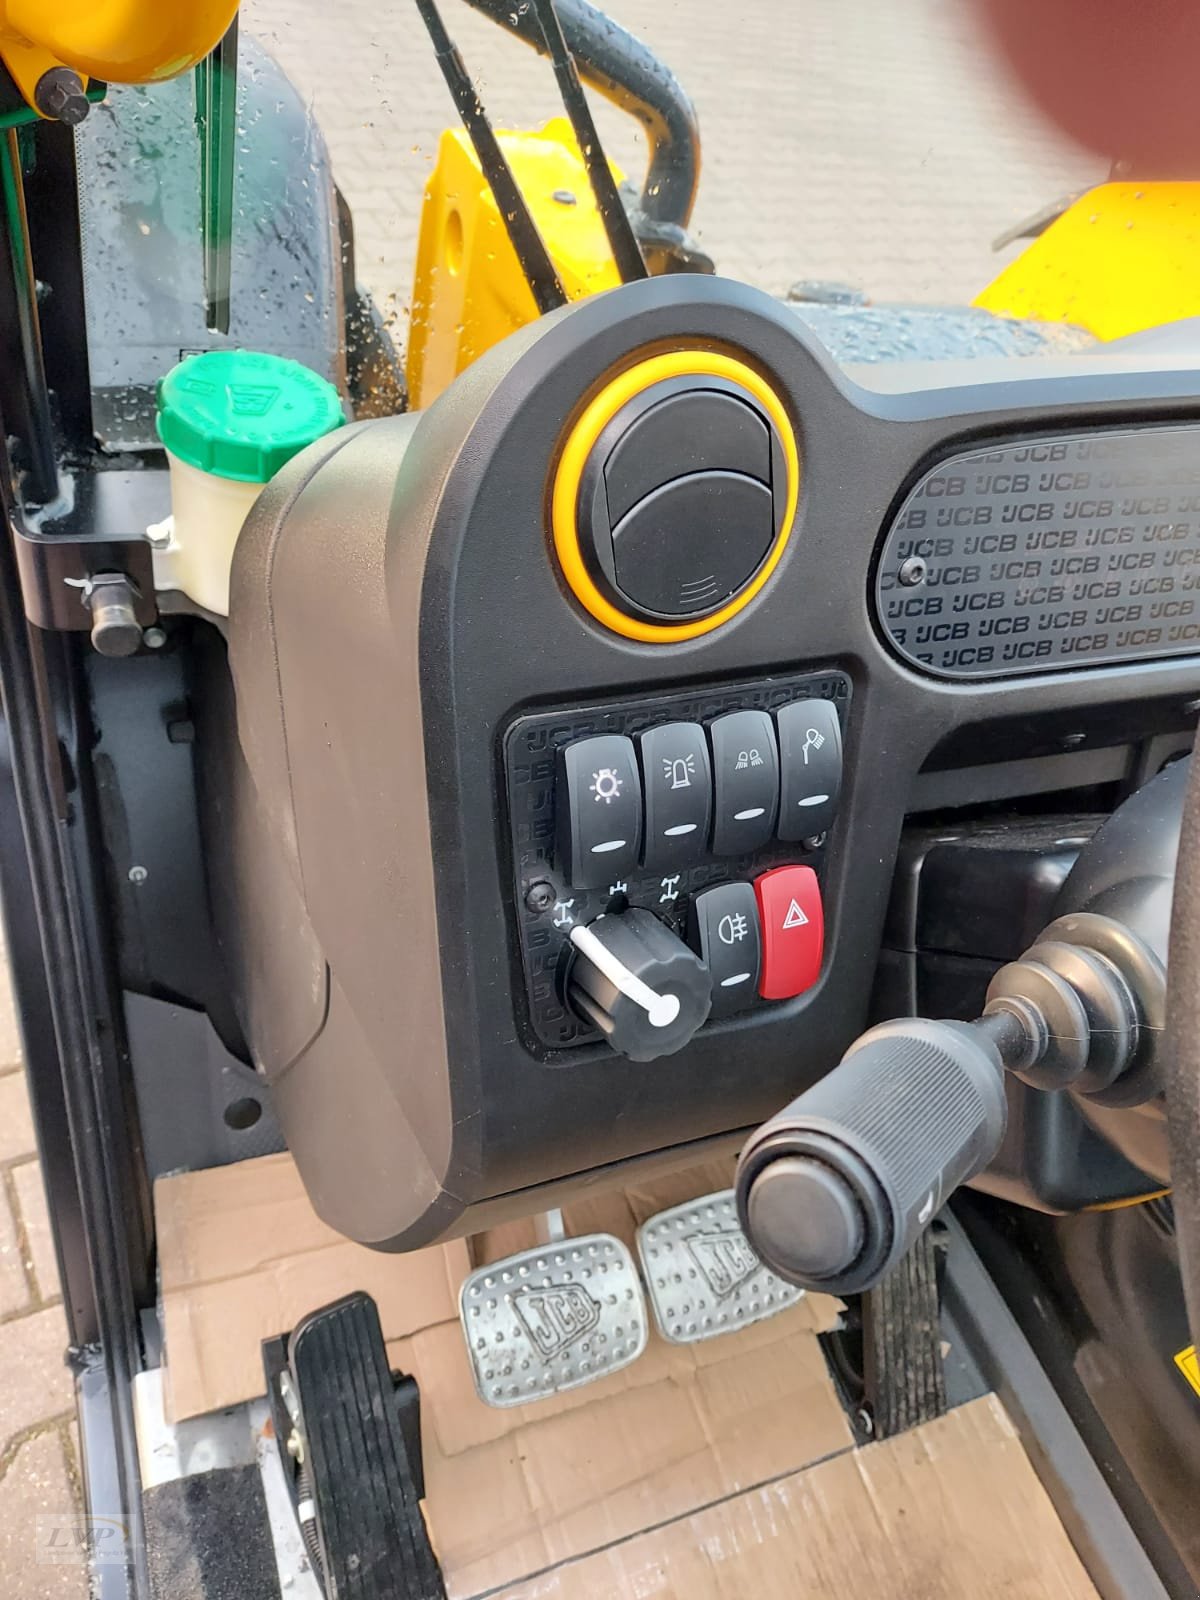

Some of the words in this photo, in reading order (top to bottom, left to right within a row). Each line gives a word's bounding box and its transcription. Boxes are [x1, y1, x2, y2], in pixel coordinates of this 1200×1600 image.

[1014, 444, 1067, 462] JCB
[976, 474, 1030, 495] JCB
[1039, 472, 1090, 492] JCB
[937, 506, 992, 527] JCB
[1001, 503, 1055, 523] JCB
[1063, 500, 1114, 520] JCB
[1121, 498, 1169, 516] JCB
[897, 538, 954, 559] JCB
[963, 534, 1017, 555] JCB
[1025, 530, 1078, 551] JCB
[1085, 526, 1135, 547] JCB
[1142, 523, 1190, 543] JCB
[926, 566, 980, 587] JCB
[990, 561, 1042, 581] JCB
[1050, 556, 1101, 577] JCB
[1108, 552, 1156, 572] JCB
[888, 597, 943, 618] JCB
[952, 592, 1005, 612] JCB
[1014, 586, 1065, 607] JCB
[1072, 581, 1122, 601] JCB
[1129, 577, 1175, 596] JCB
[916, 622, 970, 644] JCB
[979, 616, 1030, 637] JCB
[1037, 611, 1088, 631] JCB
[1095, 605, 1143, 625] JCB
[1149, 600, 1194, 619] JCB
[942, 646, 994, 668] JCB
[1003, 640, 1053, 661] JCB
[1060, 634, 1109, 654] JCB
[1116, 628, 1162, 648] JCB
[527, 1293, 590, 1347] JCB
